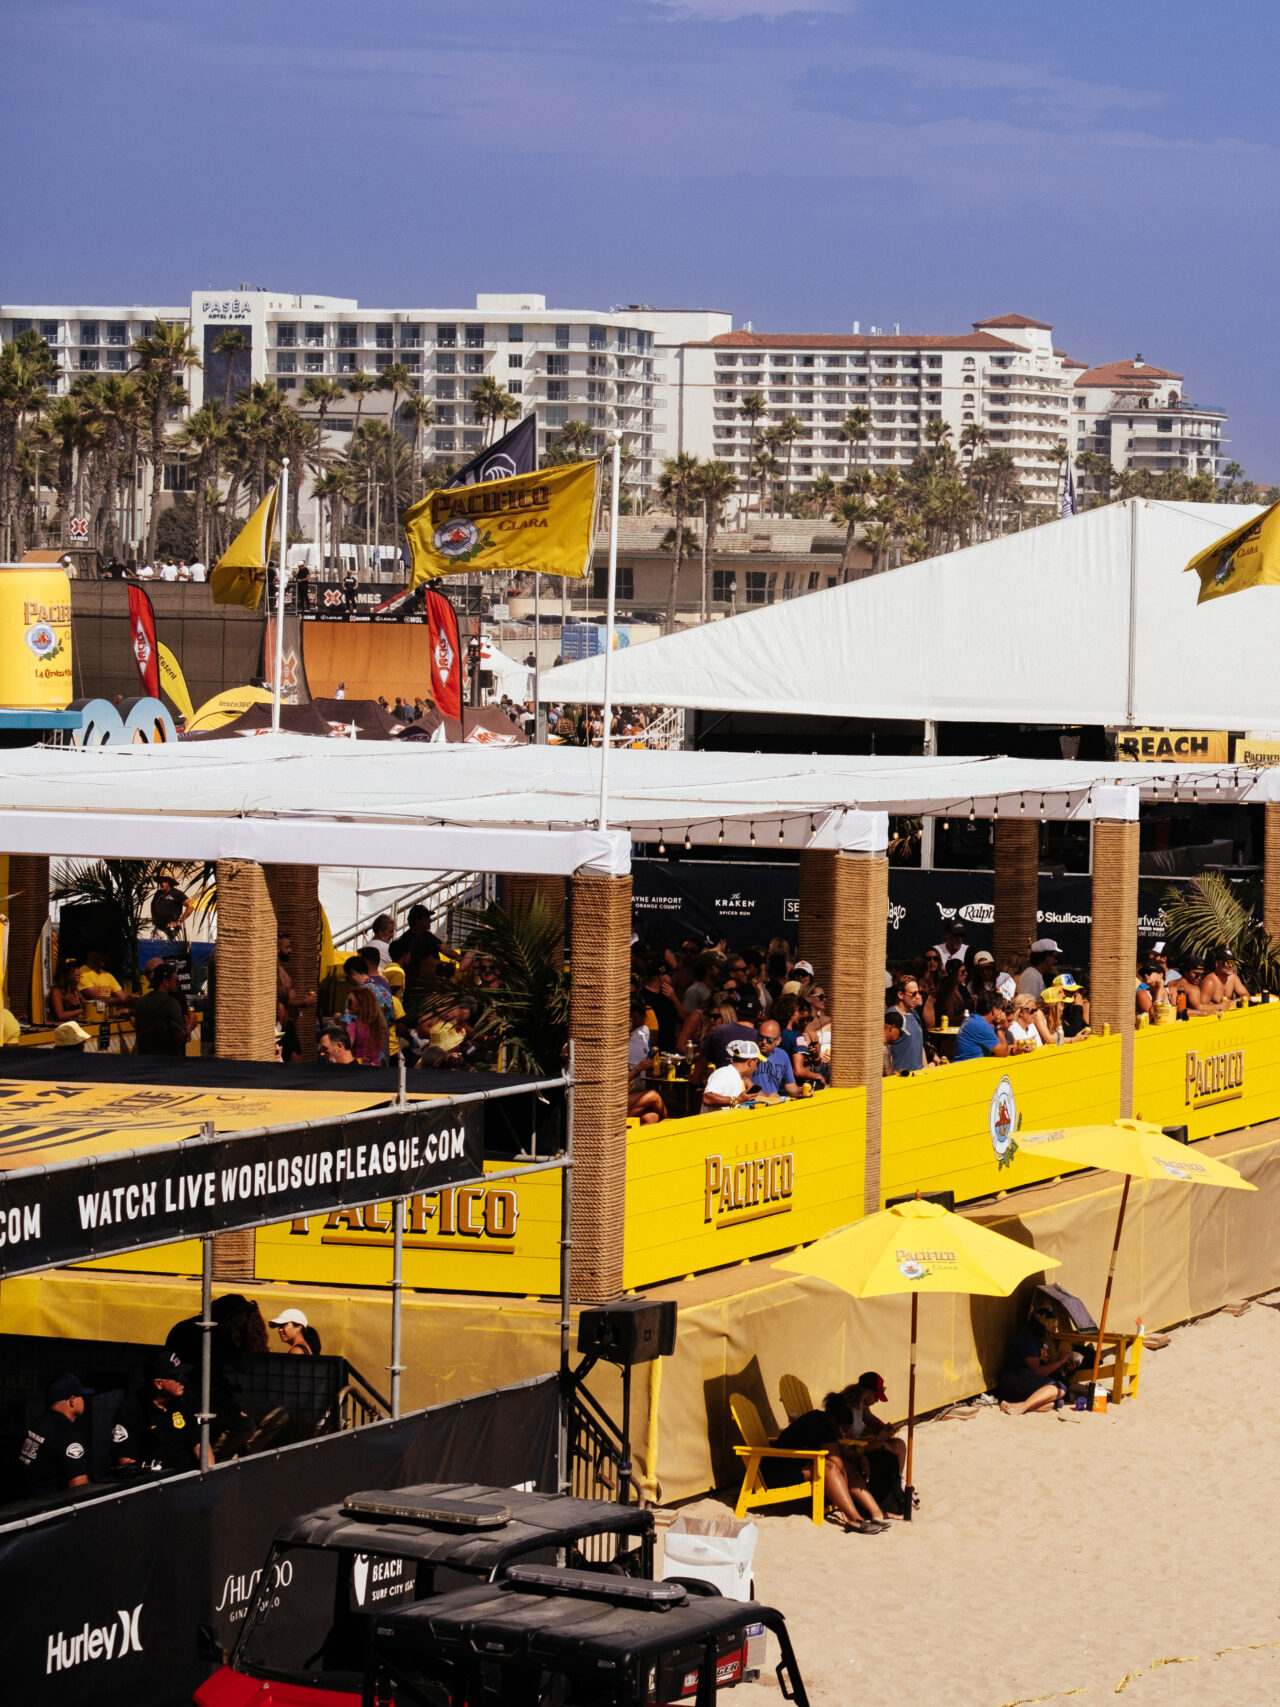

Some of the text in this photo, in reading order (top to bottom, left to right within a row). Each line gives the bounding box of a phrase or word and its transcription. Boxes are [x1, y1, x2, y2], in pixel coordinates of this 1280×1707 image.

[203, 299, 251, 313] PASÉA
[431, 485, 553, 524] PACIFICO
[498, 518, 549, 532] CLARA
[1237, 546, 1258, 558] CLARA
[438, 638, 450, 671] JACKS
[218, 700, 251, 708] Insta360
[1124, 737, 1209, 757] BEACH
[715, 899, 756, 908] KRAKEN
[1045, 912, 1092, 924] Skullcan
[1185, 1049, 1244, 1106] PACIFICO
[735, 1135, 794, 1155] CERVEZA
[78, 1181, 157, 1230] WATCH
[165, 1172, 216, 1212] LIVE
[221, 1126, 466, 1203] WORLDSURFLEAGUE.COM
[704, 1152, 794, 1225] PACIFICO
[895, 1249, 957, 1262] PACIFICO
[372, 1559, 403, 1583] BEACH
[372, 1588, 388, 1602] SURF
[389, 1584, 403, 1596] CITY
[229, 1606, 249, 1622] GINZ
[46, 1622, 118, 1675] Hurley
